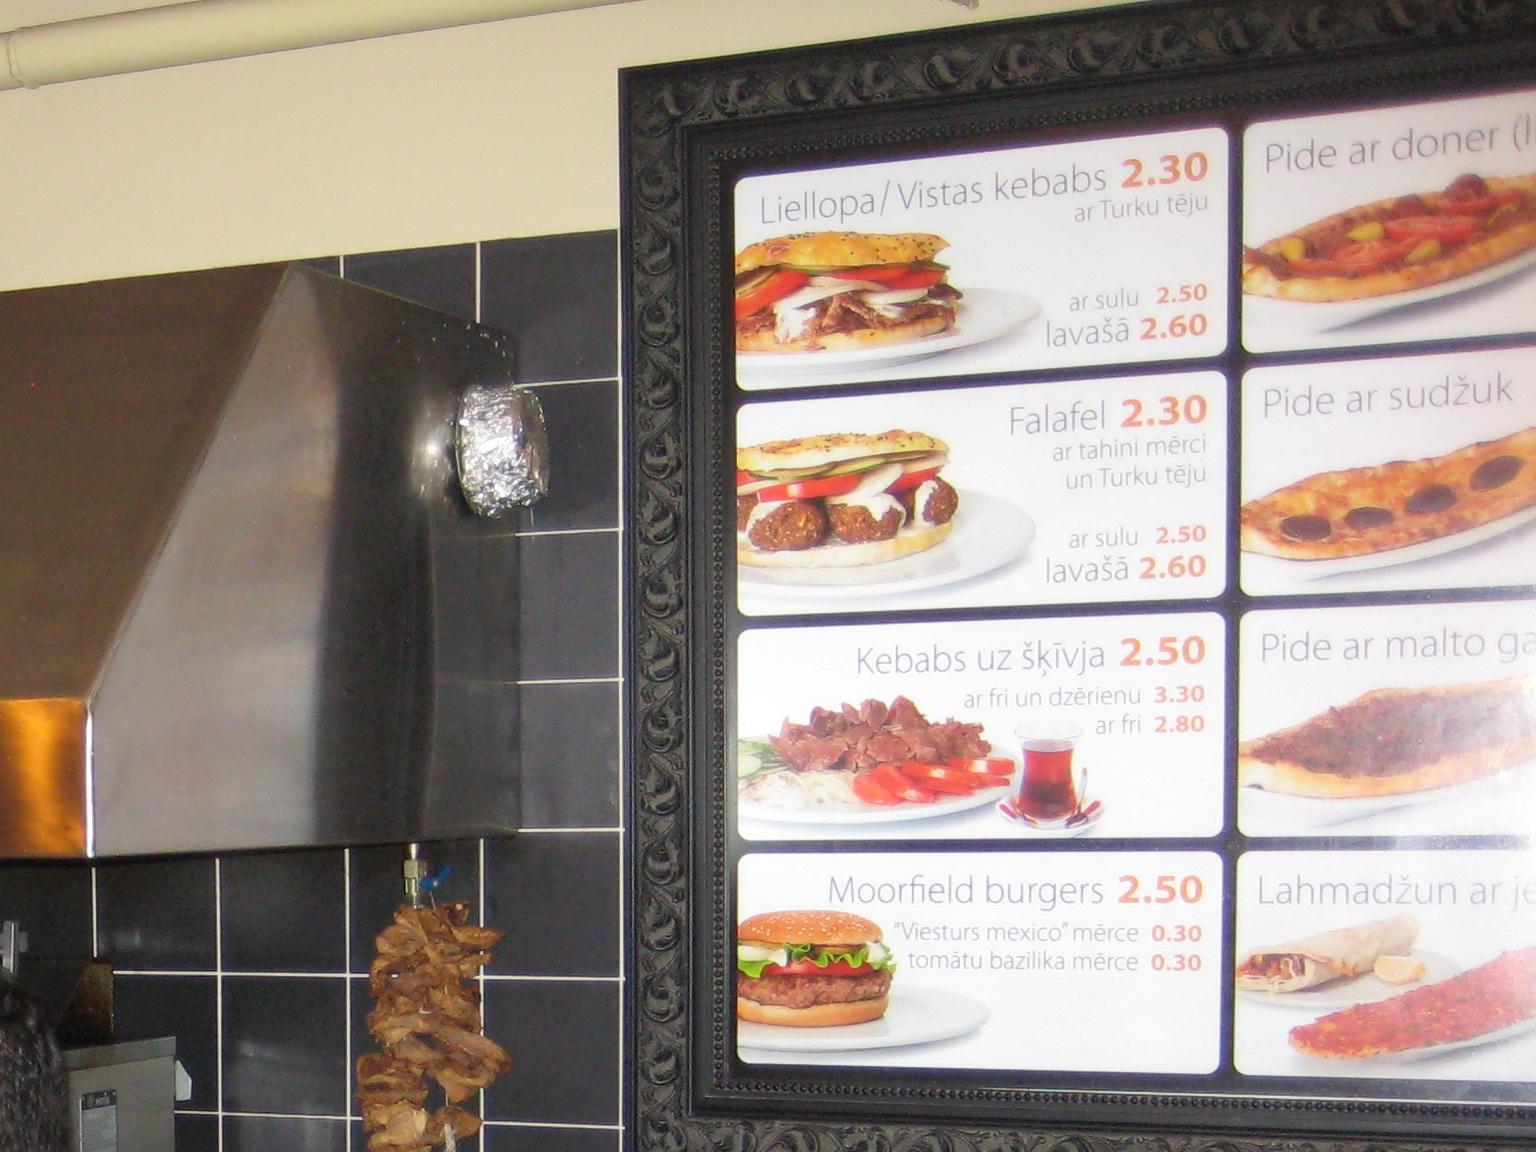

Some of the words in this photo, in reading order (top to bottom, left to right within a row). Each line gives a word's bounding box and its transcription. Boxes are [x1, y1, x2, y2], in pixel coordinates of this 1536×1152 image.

[1266, 138, 1337, 174] Pide
[1348, 140, 1381, 166] ar
[1392, 125, 1500, 161] doner
[995, 163, 1108, 201] kebabs
[1122, 151, 1209, 188] 2.30
[1074, 206, 1095, 223] ar
[1101, 196, 1160, 220] Turku
[1166, 191, 1208, 217] tēju
[1069, 295, 1090, 312] ar
[1095, 287, 1139, 310] sulu
[1156, 282, 1208, 305] 2.50
[1046, 316, 1130, 348] lavašā
[1140, 312, 1209, 340] 2.60
[1264, 384, 1335, 419] Pide
[1345, 389, 1378, 413] ar
[1389, 370, 1513, 411] sudžuk
[1010, 399, 1105, 435] Falafel
[1121, 394, 1208, 428] 2.30
[1052, 446, 1073, 462] ar
[1078, 437, 1139, 461] tahini
[1146, 433, 1207, 456] mērci
[1065, 473, 1093, 490] un
[1097, 465, 1158, 488] Turku
[1164, 463, 1207, 489] tēju
[1068, 533, 1089, 549] ar
[1095, 525, 1139, 548] sulu
[1155, 524, 1207, 545] 2.50
[1046, 554, 1129, 584] lavašā
[1139, 554, 1207, 580] 2.60
[857, 643, 967, 675] Kebabs
[977, 649, 1012, 672] uz
[1022, 639, 1105, 677] šķīvja
[1120, 635, 1207, 667] 2.50
[1261, 631, 1332, 662] Pide
[1342, 637, 1375, 661] ar
[1386, 625, 1486, 659] malto
[963, 693, 984, 709] ar
[988, 687, 1009, 708] fri
[1015, 692, 1042, 708] un
[1048, 685, 1141, 707] dzērienu
[1154, 685, 1206, 704] 3.30
[1095, 719, 1116, 735] ar
[1121, 712, 1141, 734] fri
[1154, 714, 1205, 733] 2.80
[828, 874, 974, 904] Moorfield
[985, 874, 1104, 912] burgers
[1118, 874, 1204, 904] 2.50
[1258, 873, 1457, 905] Lahmadžun
[1469, 882, 1501, 905] ar
[1072, 923, 1139, 943] mērce
[1151, 924, 1203, 943] 0.30
[908, 952, 983, 970] tomātu
[989, 950, 1065, 971] bazilika
[1072, 952, 1139, 972] mērce
[1151, 953, 1203, 972] 0.30
